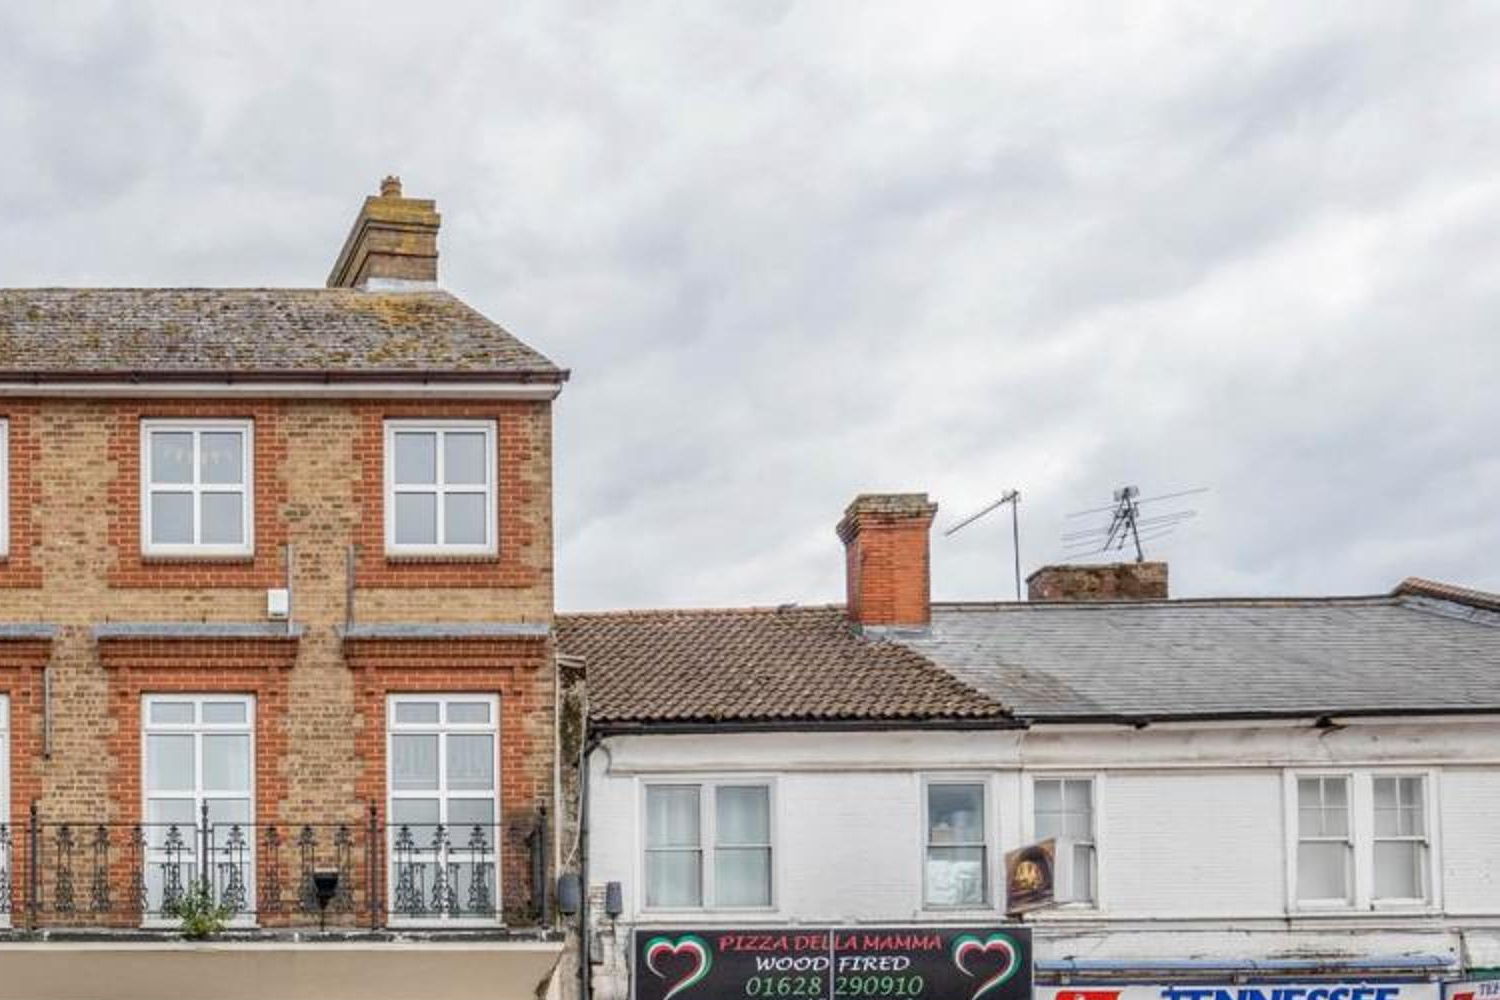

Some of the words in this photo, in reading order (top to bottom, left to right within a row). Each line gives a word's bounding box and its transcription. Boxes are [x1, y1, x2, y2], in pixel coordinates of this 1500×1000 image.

[719, 934, 788, 952] PIZZA
[794, 935, 858, 950] DELLA
[863, 934, 942, 950] MAMMA
[755, 955, 830, 971] WOOD
[838, 955, 911, 972] FIRED
[745, 975, 822, 996] 01628
[835, 975, 924, 996] 290910
